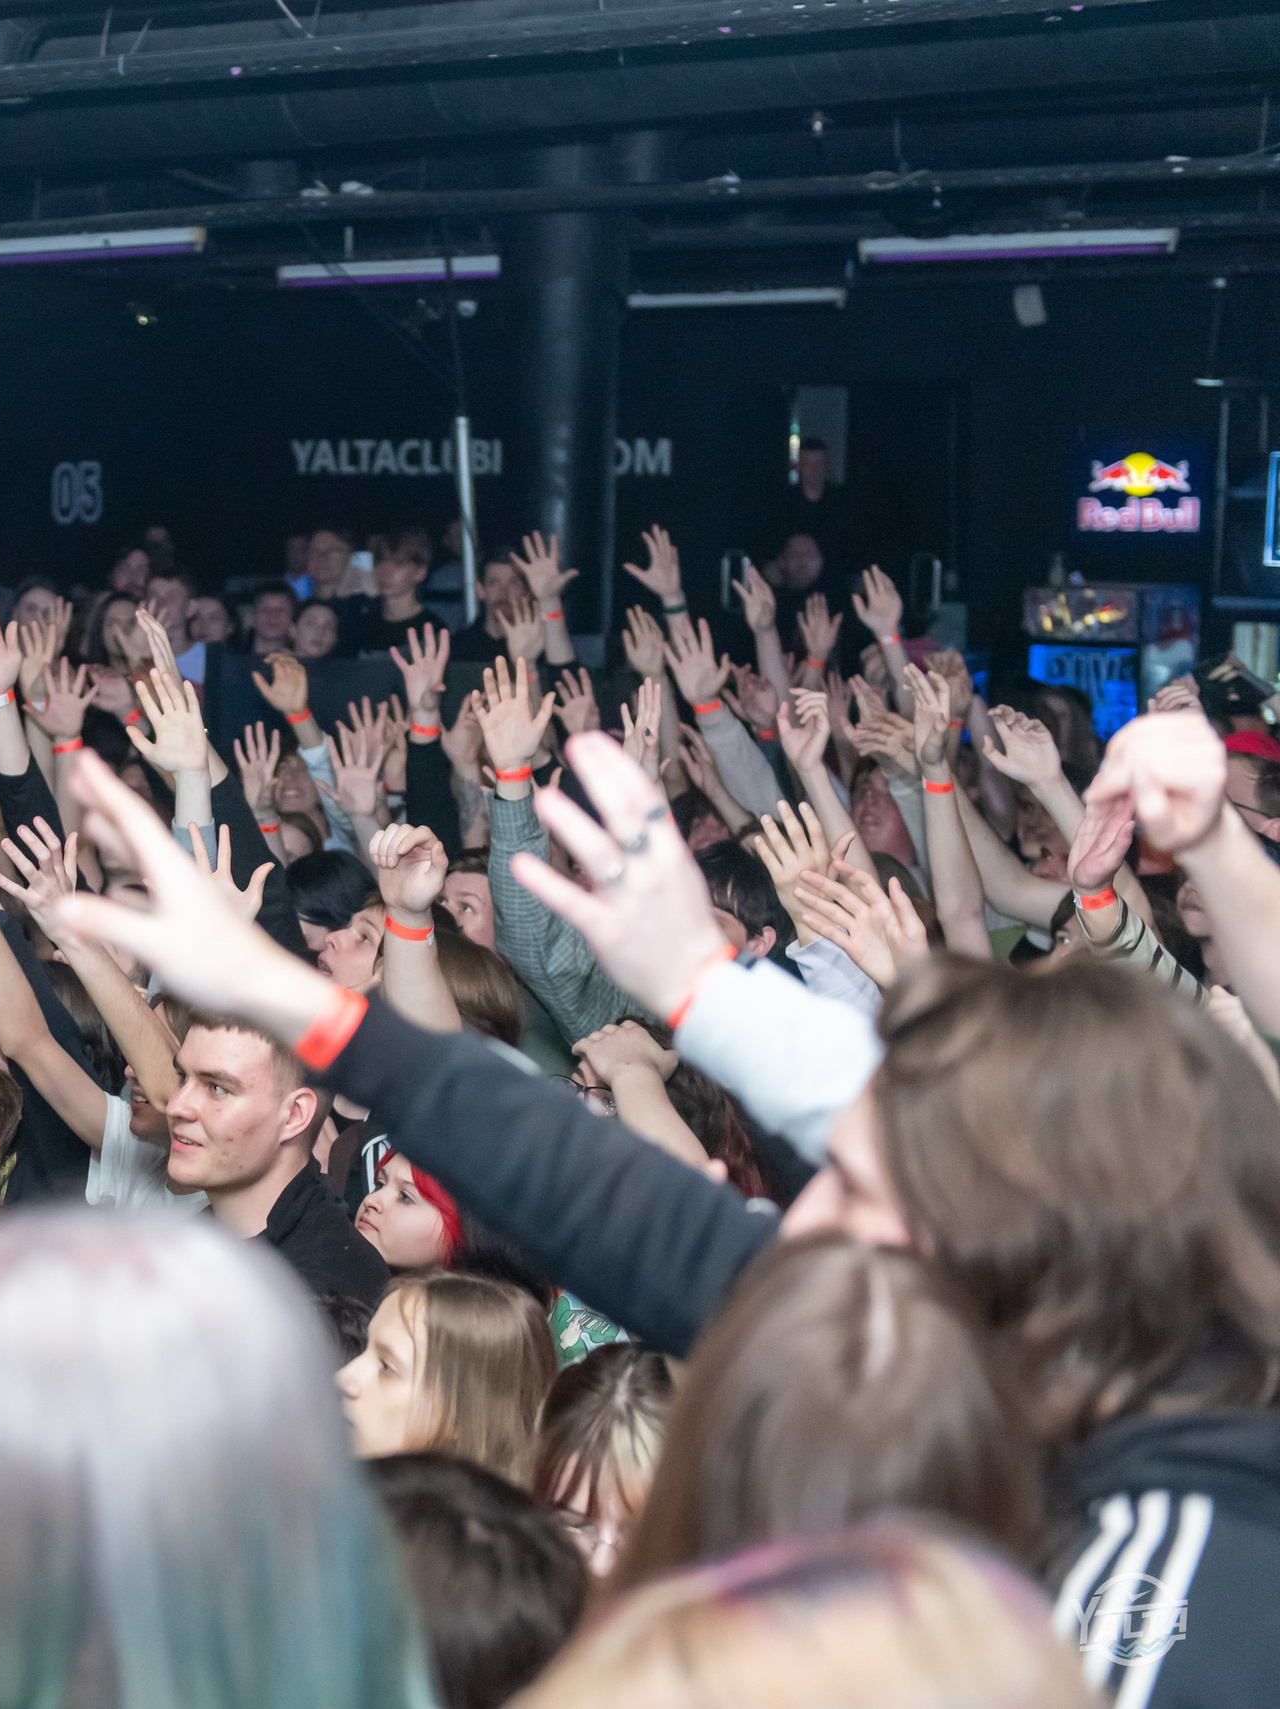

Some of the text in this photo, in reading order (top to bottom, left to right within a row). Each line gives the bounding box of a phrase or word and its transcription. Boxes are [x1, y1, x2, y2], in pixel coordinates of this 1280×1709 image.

[51, 461, 103, 525] 05
[1077, 496, 1201, 533] Red Bull
